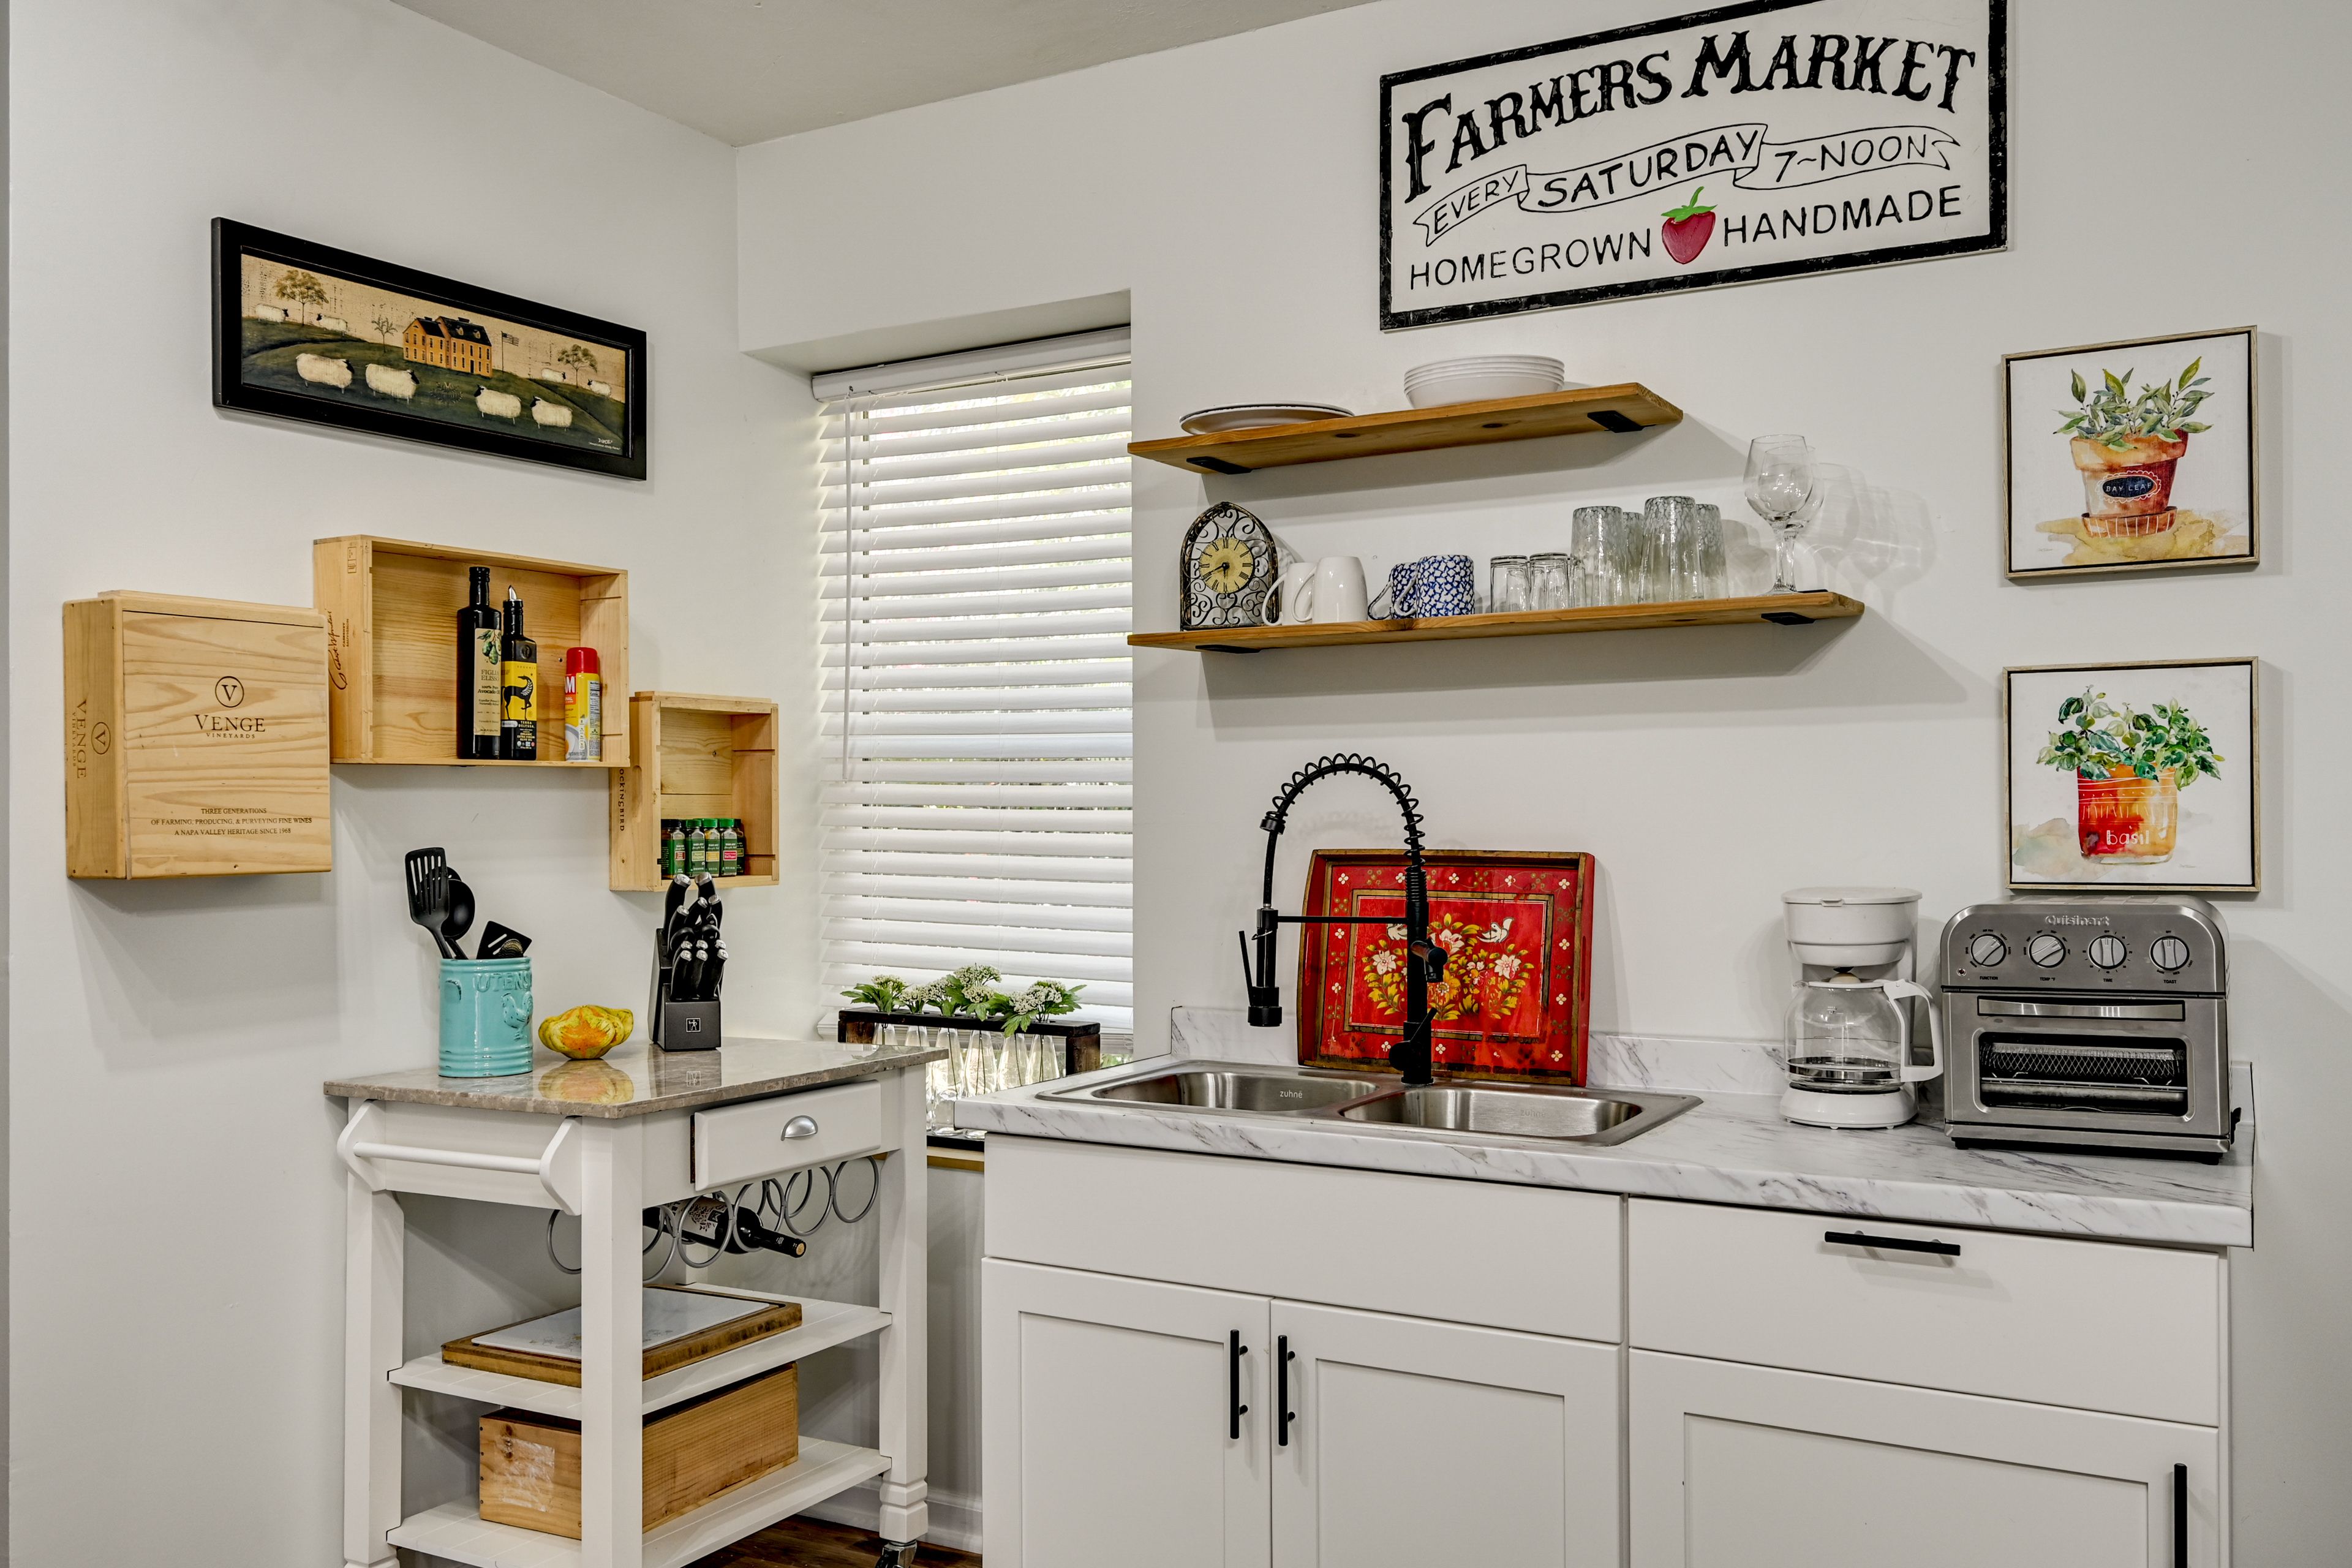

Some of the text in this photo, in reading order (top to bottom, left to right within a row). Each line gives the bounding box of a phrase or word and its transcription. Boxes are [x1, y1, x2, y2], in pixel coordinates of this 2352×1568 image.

[1403, 30, 1977, 205] FARMERS MARKET
[1433, 168, 1520, 234] EVERY
[1539, 130, 1760, 208] SATURDAY
[1410, 185, 1962, 290] HOMEGROWN HANDMADE
[2128, 482, 2152, 491] LEAF
[221, 684, 238, 702] V
[194, 714, 266, 732] VENGE
[77, 699, 87, 779] VENGE
[2106, 829, 2149, 845] basil
[2045, 914, 2110, 926] Cuisinart
